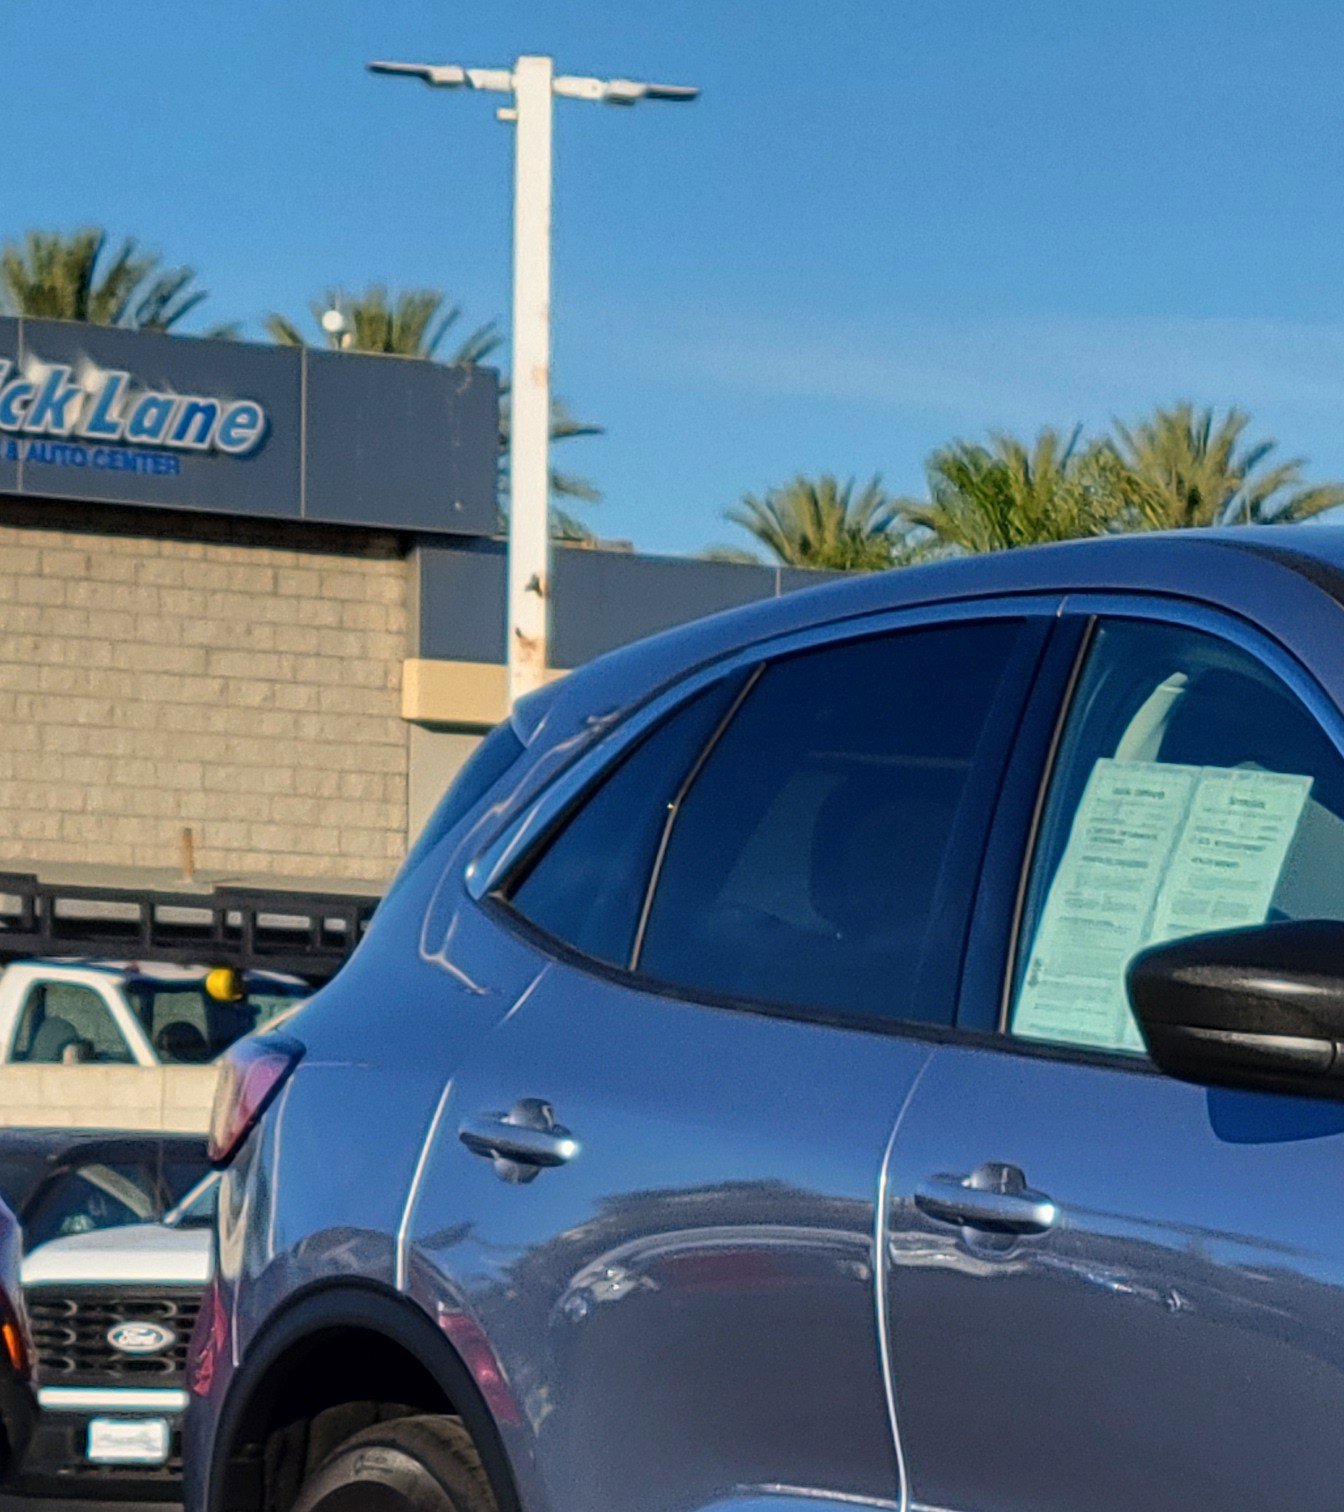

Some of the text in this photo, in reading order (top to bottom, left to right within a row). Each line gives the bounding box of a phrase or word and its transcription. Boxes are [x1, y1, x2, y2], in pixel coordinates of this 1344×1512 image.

[0, 358, 266, 455] ck Lane
[27, 441, 88, 468] AUTO
[92, 447, 182, 476] CENTER
